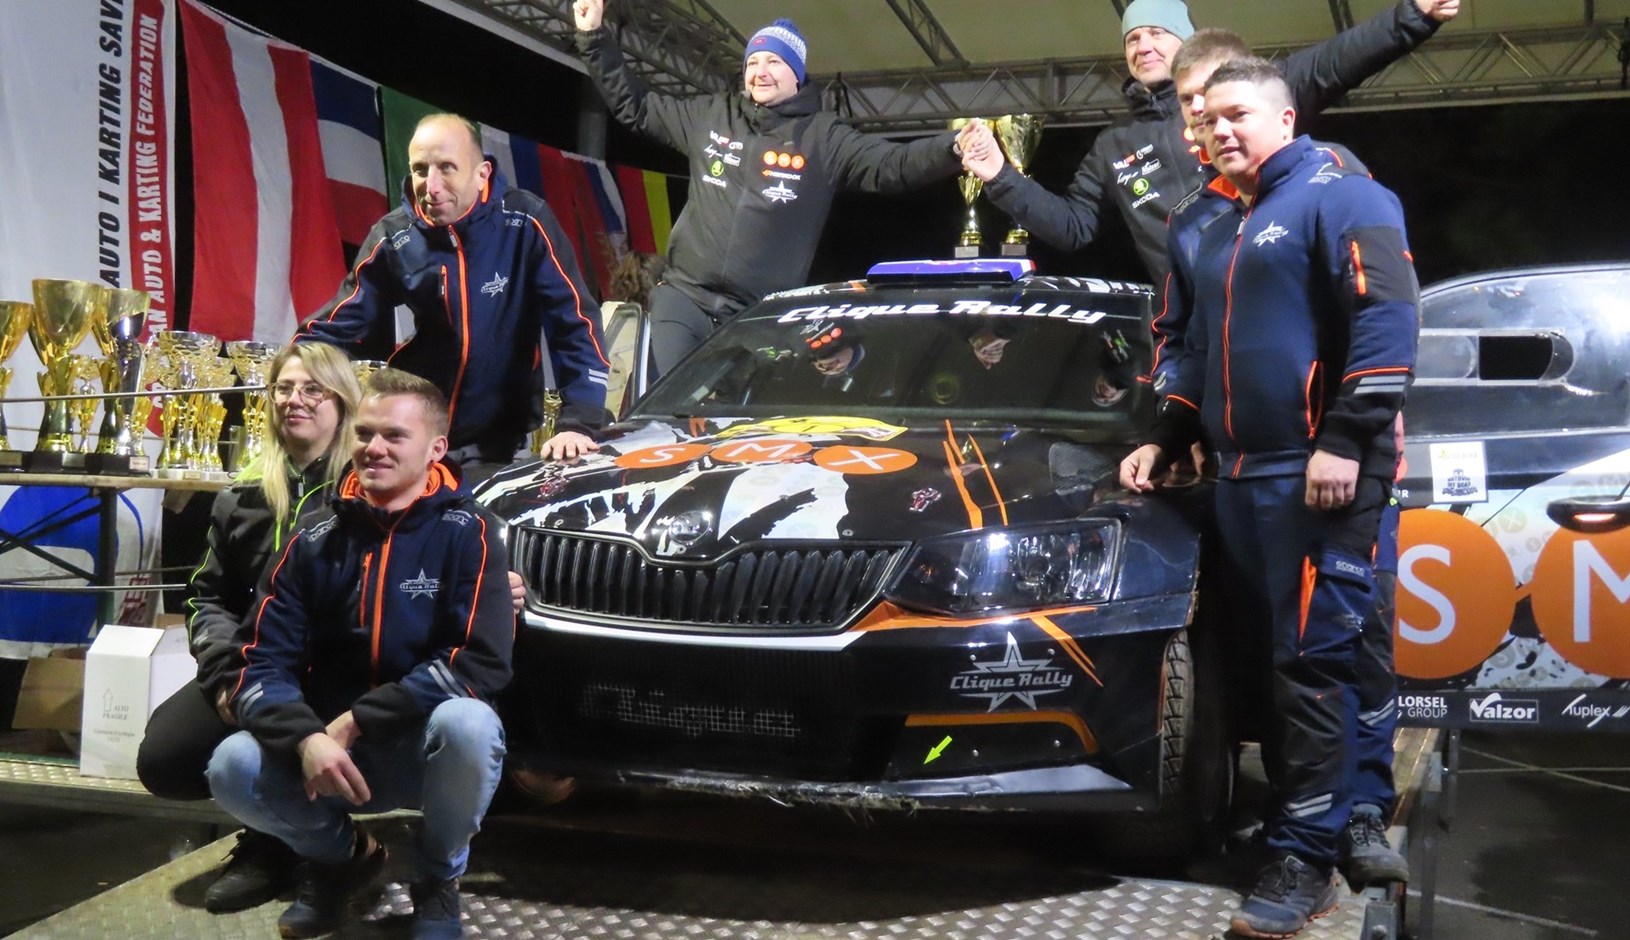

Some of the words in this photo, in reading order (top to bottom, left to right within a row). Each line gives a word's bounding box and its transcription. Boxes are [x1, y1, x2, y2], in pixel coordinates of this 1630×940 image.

[99, 0, 124, 57] SAV
[136, 13, 158, 136] FEDERATION
[98, 63, 122, 185] KARTING
[98, 190, 120, 205] I
[136, 141, 162, 222] KARTING
[98, 212, 120, 289] AUTO
[140, 229, 161, 243] &
[141, 250, 165, 303] AUTO
[777, 303, 941, 323] Clique
[948, 300, 1107, 324] Rally
[949, 675, 1016, 691] Clique
[1019, 672, 1073, 688] Rally
[1407, 707, 1448, 718] GROUP
[1470, 692, 1536, 719] Valzor
